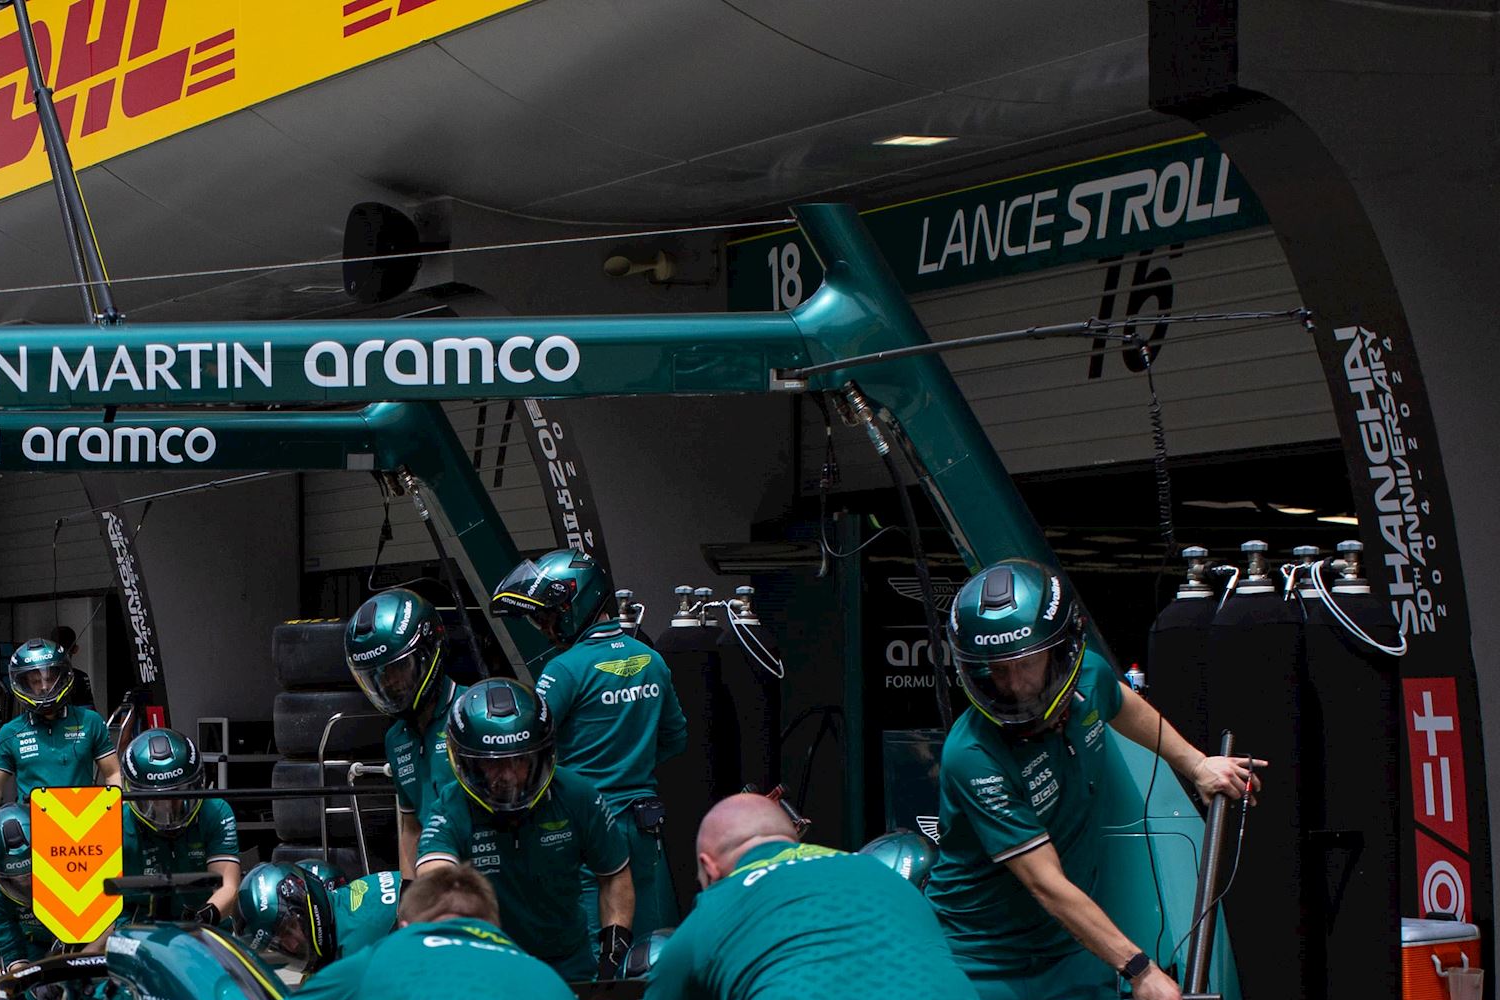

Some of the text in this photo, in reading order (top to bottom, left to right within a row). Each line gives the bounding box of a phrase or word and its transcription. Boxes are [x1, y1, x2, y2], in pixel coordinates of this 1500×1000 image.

[918, 153, 1240, 275] LANCE STROLL
[767, 242, 803, 311] 18
[49, 341, 273, 394] MARTIN
[304, 335, 581, 388] aramco
[22, 425, 217, 463] aramco
[1359, 326, 1427, 567] ANNIVERSARY
[1333, 326, 1420, 636] SHANGHAI
[102, 511, 147, 683] SHANGHAI
[1043, 575, 1061, 621] Valvoline
[516, 601, 537, 612] MARTIN
[396, 599, 413, 635] Valvoline
[974, 626, 1032, 645] aramco
[352, 644, 387, 661] aramco
[610, 641, 625, 649] BOSS
[24, 653, 53, 663] aramco
[886, 675, 952, 688] FORMU
[601, 683, 660, 705] aramco
[483, 730, 530, 744] aramco
[397, 753, 412, 765] BOSS
[147, 768, 184, 781] aramco
[1029, 767, 1053, 791] BOSS
[1031, 779, 1060, 807] JCB
[540, 831, 573, 843] aramco
[51, 844, 104, 857] BRAKES
[472, 842, 497, 853] BOSS
[6, 859, 31, 870] aram
[66, 861, 88, 873] ON
